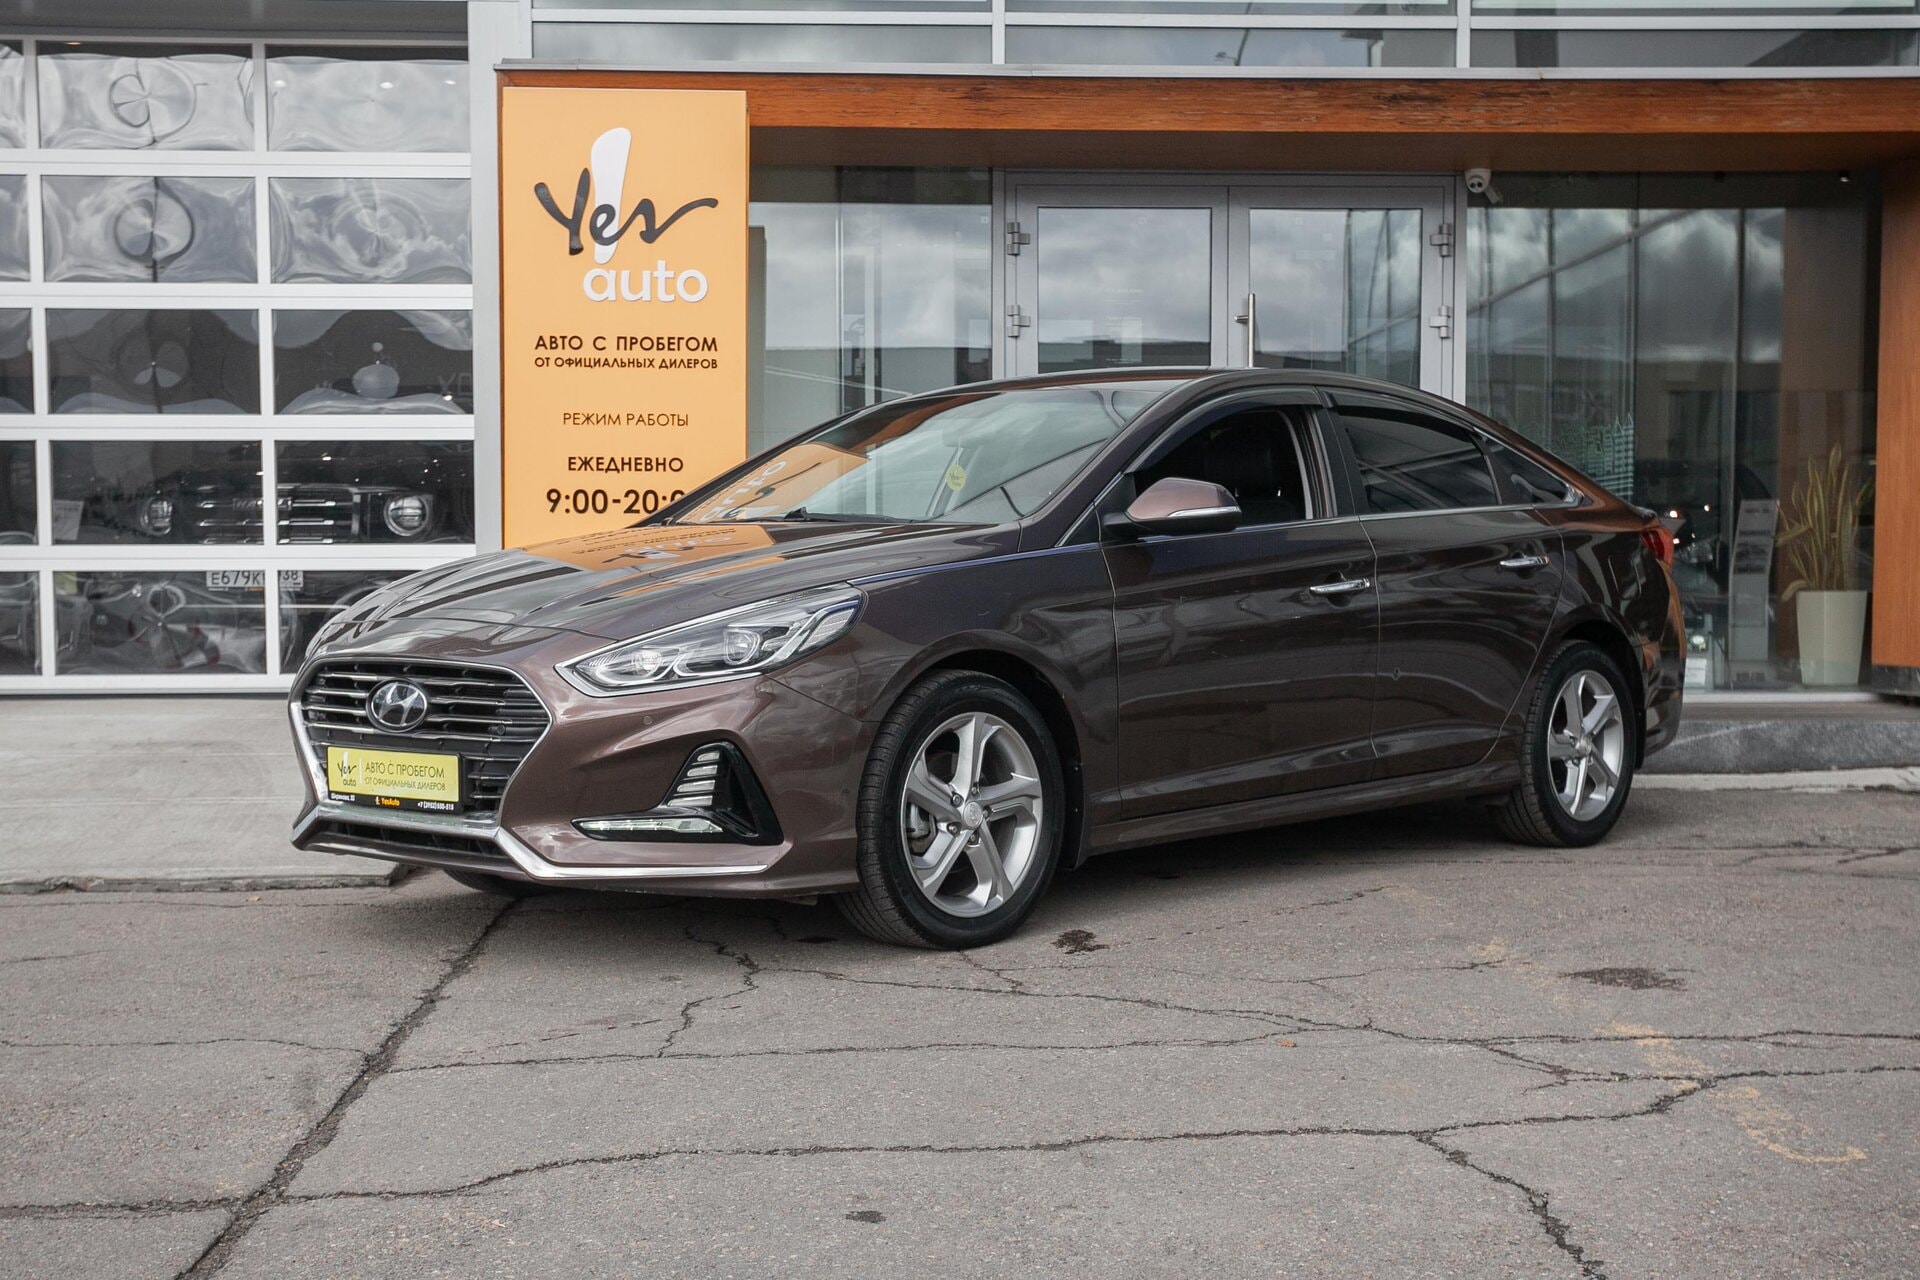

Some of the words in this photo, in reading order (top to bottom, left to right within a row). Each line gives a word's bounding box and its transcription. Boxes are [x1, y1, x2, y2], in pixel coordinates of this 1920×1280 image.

[582, 259, 709, 303] auto
[534, 335, 583, 351] АВТО
[592, 336, 607, 351] С
[616, 336, 718, 352] ПРОБЕГОМ
[534, 357, 551, 368] ОТ
[554, 357, 655, 369] ОФИЦИАЛЬНЫХ
[658, 358, 718, 369] ДИЛЕРОВ
[563, 412, 621, 426] РЕЖИМ
[626, 413, 689, 427] РАБОТЫ
[567, 456, 684, 473] ЕЖЕДНЕВНО
[365, 762, 385, 775] АВТО
[387, 763, 394, 775] С
[396, 764, 445, 779] ПРОБЕГОМ
[343, 779, 357, 787] auto
